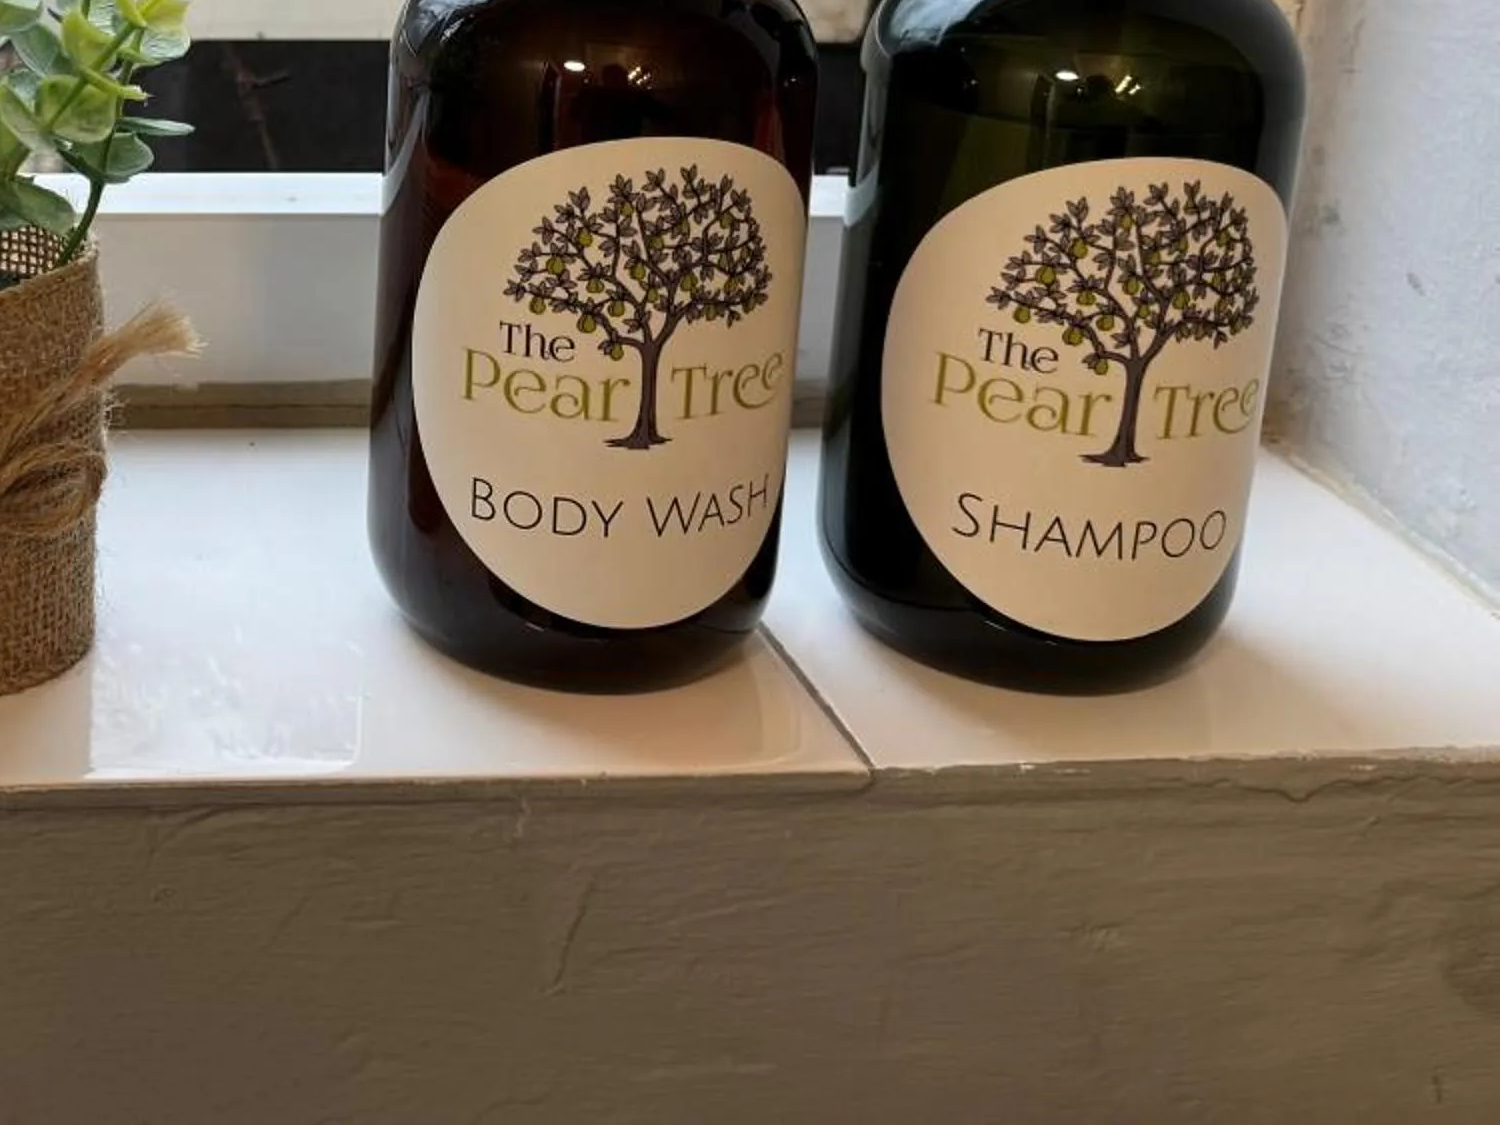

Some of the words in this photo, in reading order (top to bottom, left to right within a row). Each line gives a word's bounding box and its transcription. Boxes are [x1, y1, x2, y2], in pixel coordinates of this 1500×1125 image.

[499, 321, 575, 363] The
[977, 327, 1060, 374] The
[460, 345, 631, 423] Pear
[670, 348, 786, 422] Tree
[931, 351, 1112, 438] Pear
[1153, 378, 1260, 441] Tree
[470, 477, 624, 539] BODY
[646, 474, 770, 538] WASH
[951, 491, 1228, 562] SHAMPOO
